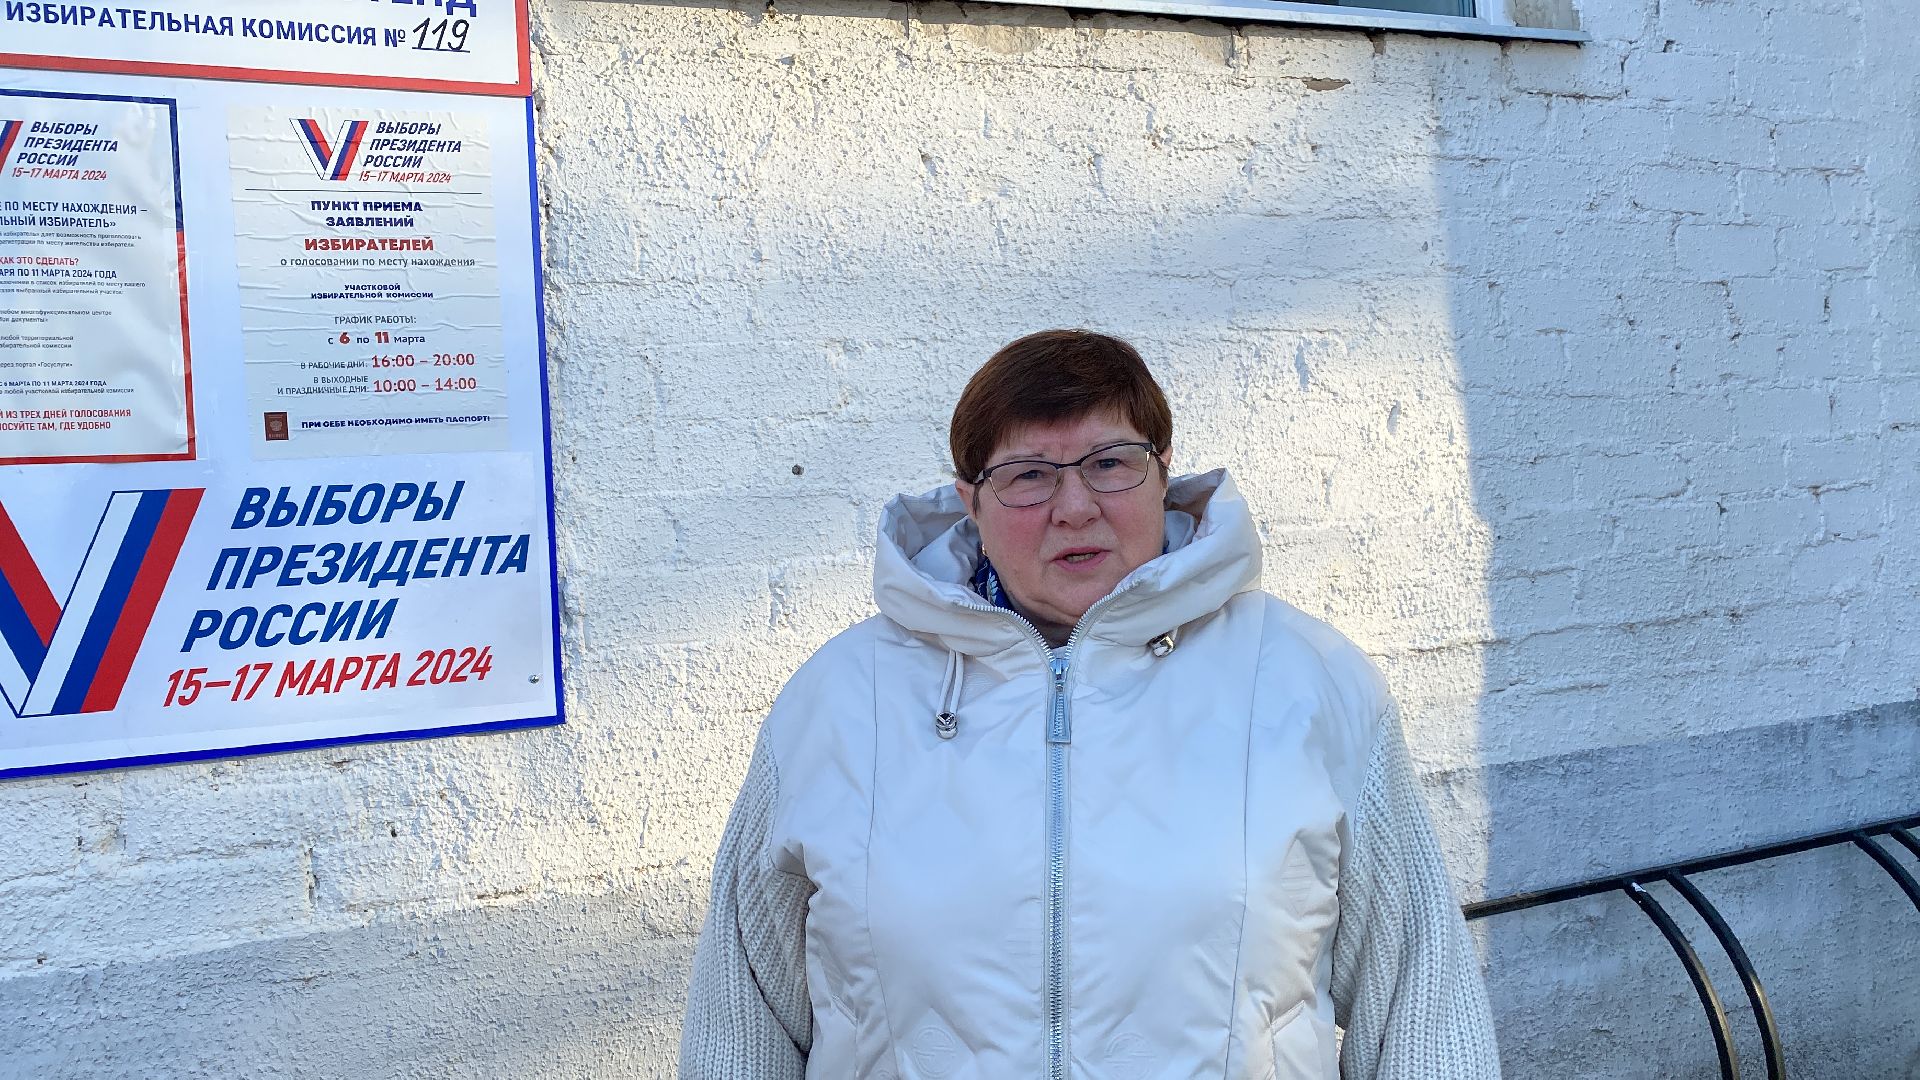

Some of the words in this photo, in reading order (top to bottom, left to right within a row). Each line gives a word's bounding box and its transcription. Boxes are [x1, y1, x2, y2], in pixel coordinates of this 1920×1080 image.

[6, 1, 234, 37] ИЗБИРАТЕЛЬНАЯ
[242, 18, 376, 46] КОМИССИЯ
[412, 17, 470, 52] 119
[31, 121, 98, 135] ВЫБОРЫ
[376, 122, 441, 135] ВЫБОРЫ
[24, 137, 118, 152] ПРЕЗИДЕНТА
[369, 139, 462, 153] ПРЕЗИДЕНТА
[17, 153, 78, 166] РОССИИ
[363, 155, 423, 168] РОССИИ
[43, 169, 79, 179] МАРТА
[81, 170, 107, 180] 2024
[389, 172, 424, 182] МАРТА
[426, 173, 452, 183] 2024
[5, 201, 18, 211] ПО
[23, 201, 59, 212] МЕСТУ
[62, 203, 137, 215] НАХОЖДЕНИЯ
[311, 201, 359, 211] ПУНКТ
[363, 201, 423, 212] ПРИЕМА
[39, 217, 116, 228] ИЗБИРАТЕЛЬ»
[326, 215, 414, 227] ЗАЯВЛЕНИЙ
[304, 236, 434, 251] ИЗБИРАТЕЛЕЙ
[36, 257, 79, 266] СДЕЛАТЬ?
[290, 257, 359, 267] голосовании
[362, 258, 375, 267] по
[378, 258, 408, 268] месту
[411, 257, 475, 267] нахождения
[42, 269, 70, 277] МАРТА
[72, 269, 92, 278] 2024
[94, 270, 117, 279] ГОДА
[334, 316, 373, 325] ГРАФИК
[375, 315, 416, 325] РАБОТЫ:
[339, 332, 350, 345] 6
[356, 337, 370, 345] по
[375, 332, 389, 344] 11
[393, 335, 426, 346] марта
[371, 355, 415, 368] 16:00
[432, 353, 475, 366] 20:00
[321, 376, 369, 384] ВЫХОДНЫЕ
[373, 379, 417, 393] 10:00
[435, 378, 476, 391] 14:00
[6, 410, 18, 418] ИЗ
[20, 410, 41, 418] ТРЕХ
[43, 408, 67, 419] ДНЕЙ
[70, 409, 132, 418] ГОЛОСОВАНИЯ
[37, 422, 57, 432] ТАМ,
[60, 422, 76, 430] ГДЕ
[77, 421, 111, 430] УДОБНО
[347, 418, 413, 427] НЕОБХОДИМО
[231, 480, 466, 530] ВЫБОРЫ
[206, 534, 531, 591] ПРЕЗИДЕНТА
[180, 598, 400, 653] РОССИИ
[274, 652, 402, 697] МАРТА
[406, 645, 493, 687] 2024
